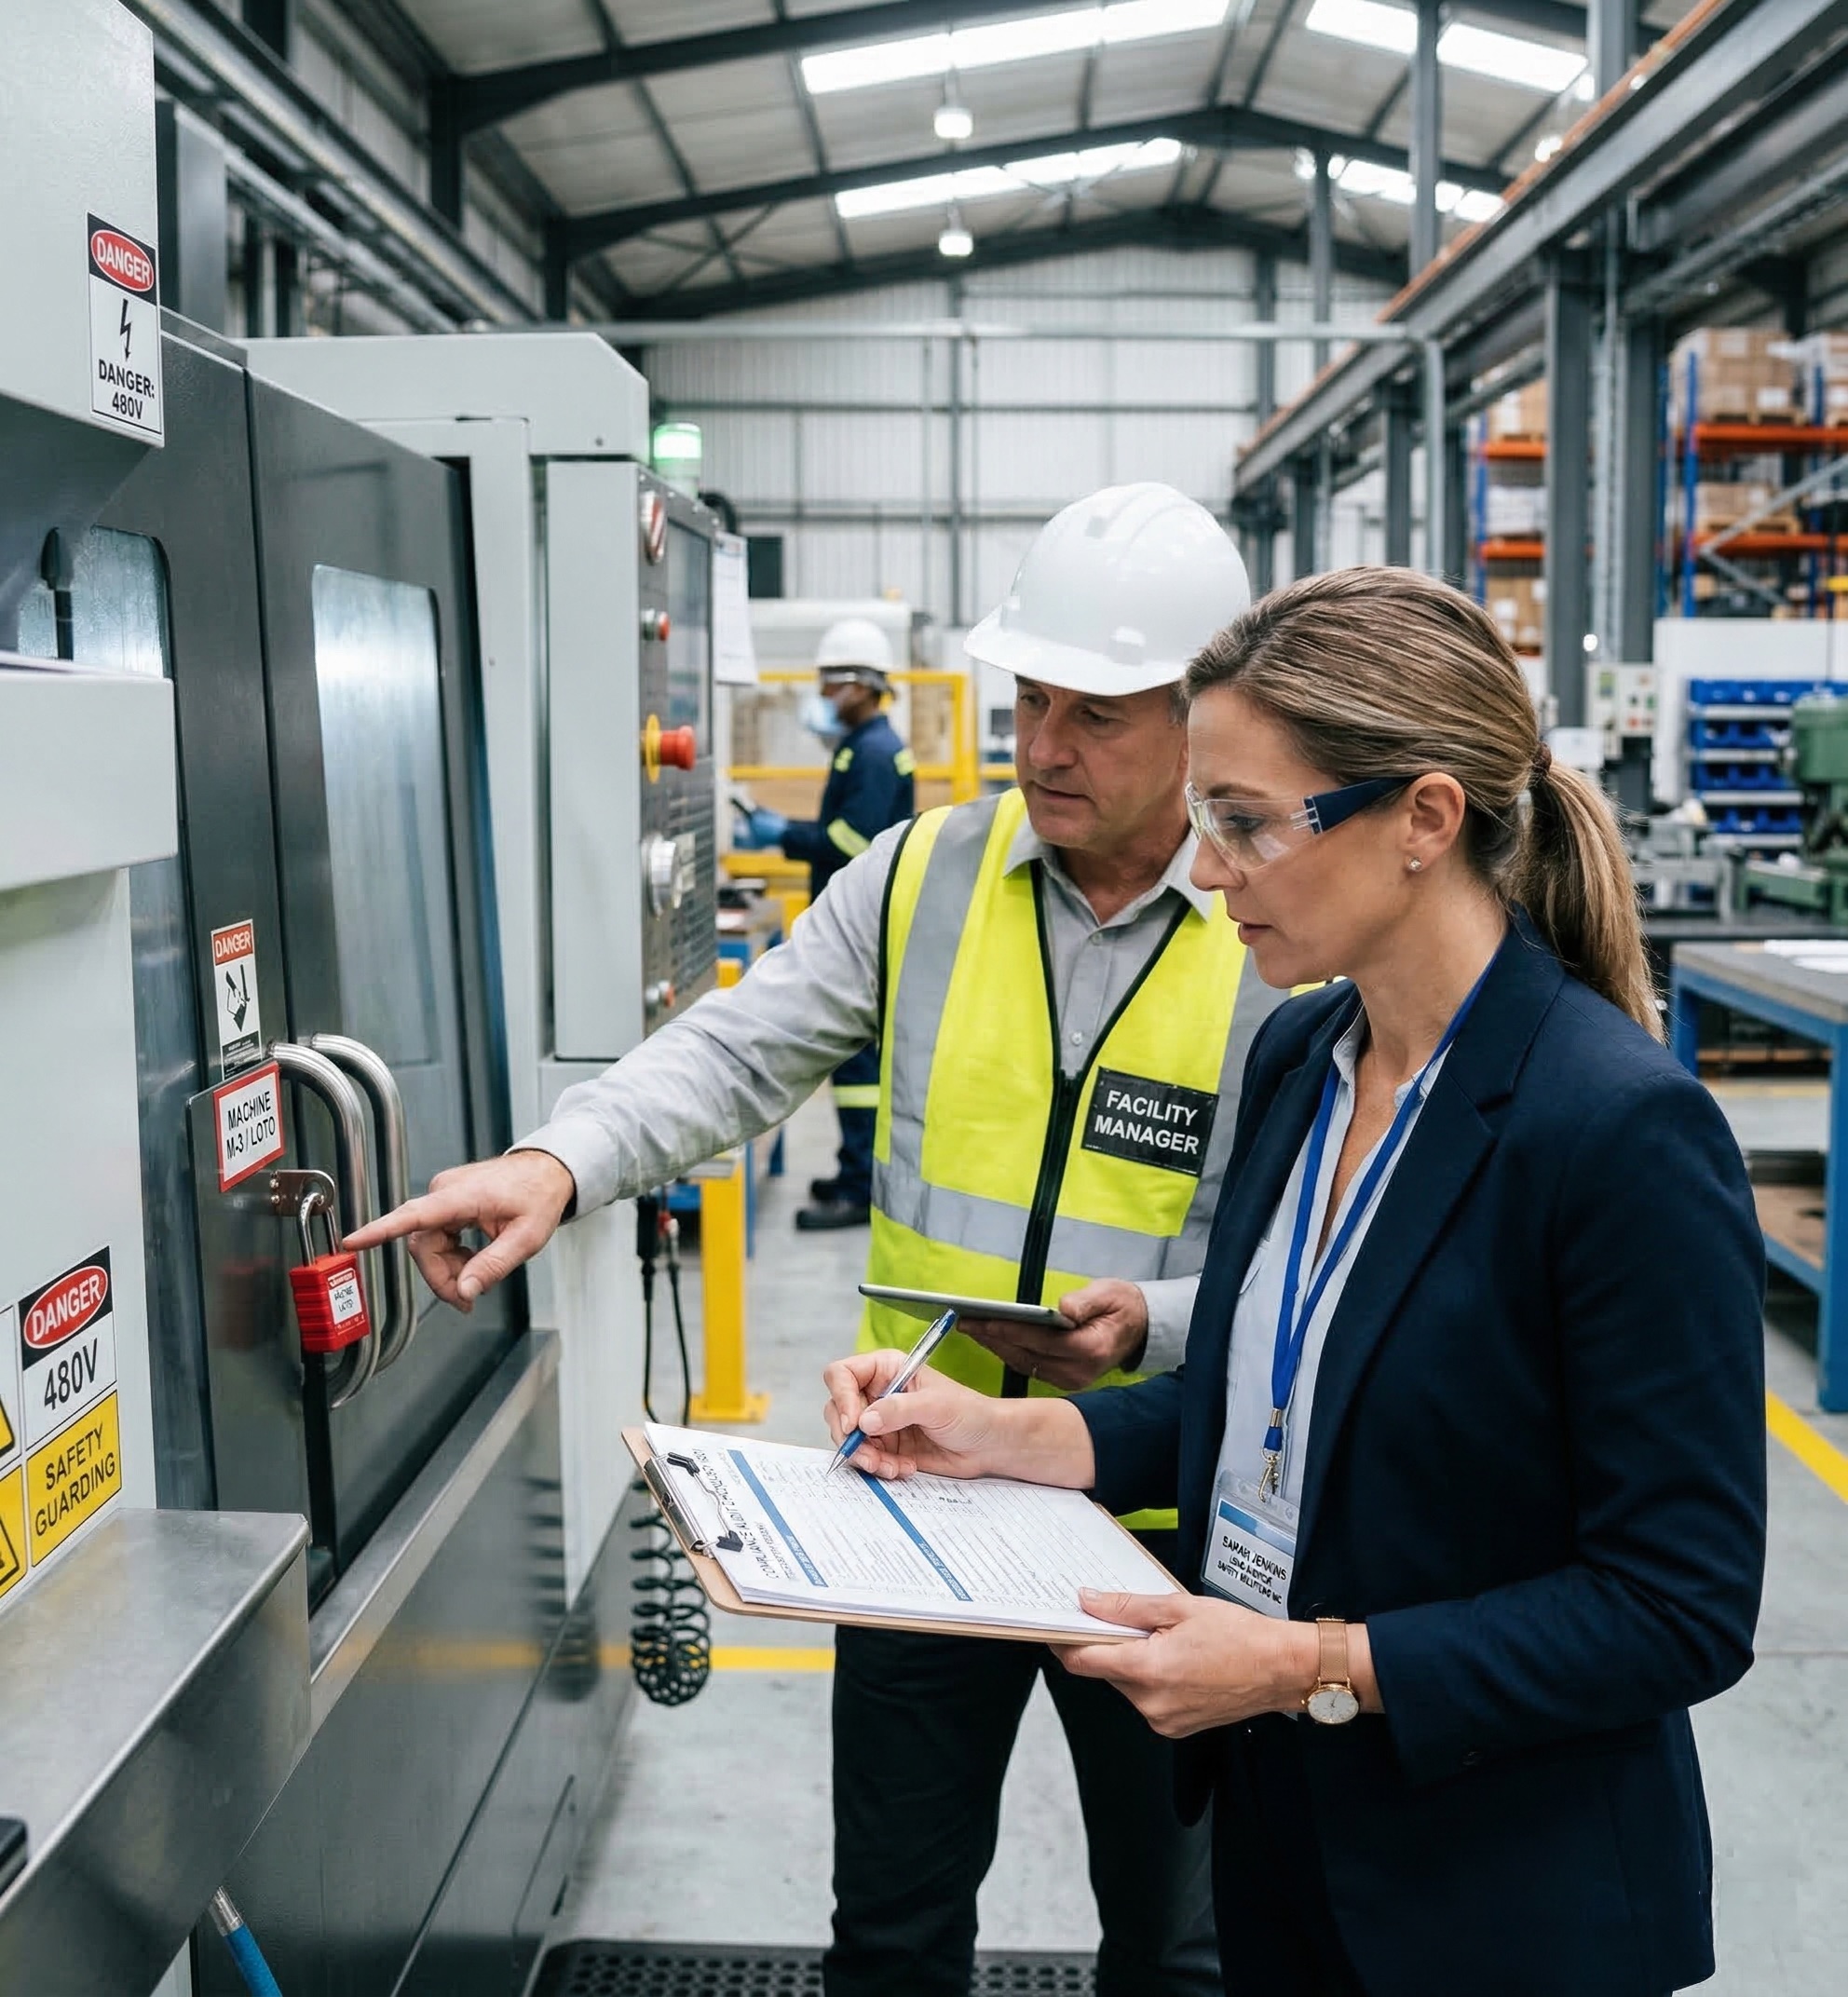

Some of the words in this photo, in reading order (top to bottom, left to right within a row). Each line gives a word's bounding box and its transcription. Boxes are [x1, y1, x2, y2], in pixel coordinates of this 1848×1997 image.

[97, 236, 151, 287] DANGER
[99, 359, 155, 399] DANGER:
[112, 391, 143, 420] 480V
[215, 931, 251, 958] DANGER
[227, 1091, 271, 1131] MACHINE
[1106, 1090, 1198, 1126] FACILITY
[251, 1116, 276, 1146] LOTO
[1094, 1115, 1200, 1155] MANAGER
[32, 1273, 102, 1342] DANGER
[44, 1338, 98, 1411] 480V
[46, 1421, 103, 1491] SAFETY
[34, 1452, 116, 1537] GUARDING
